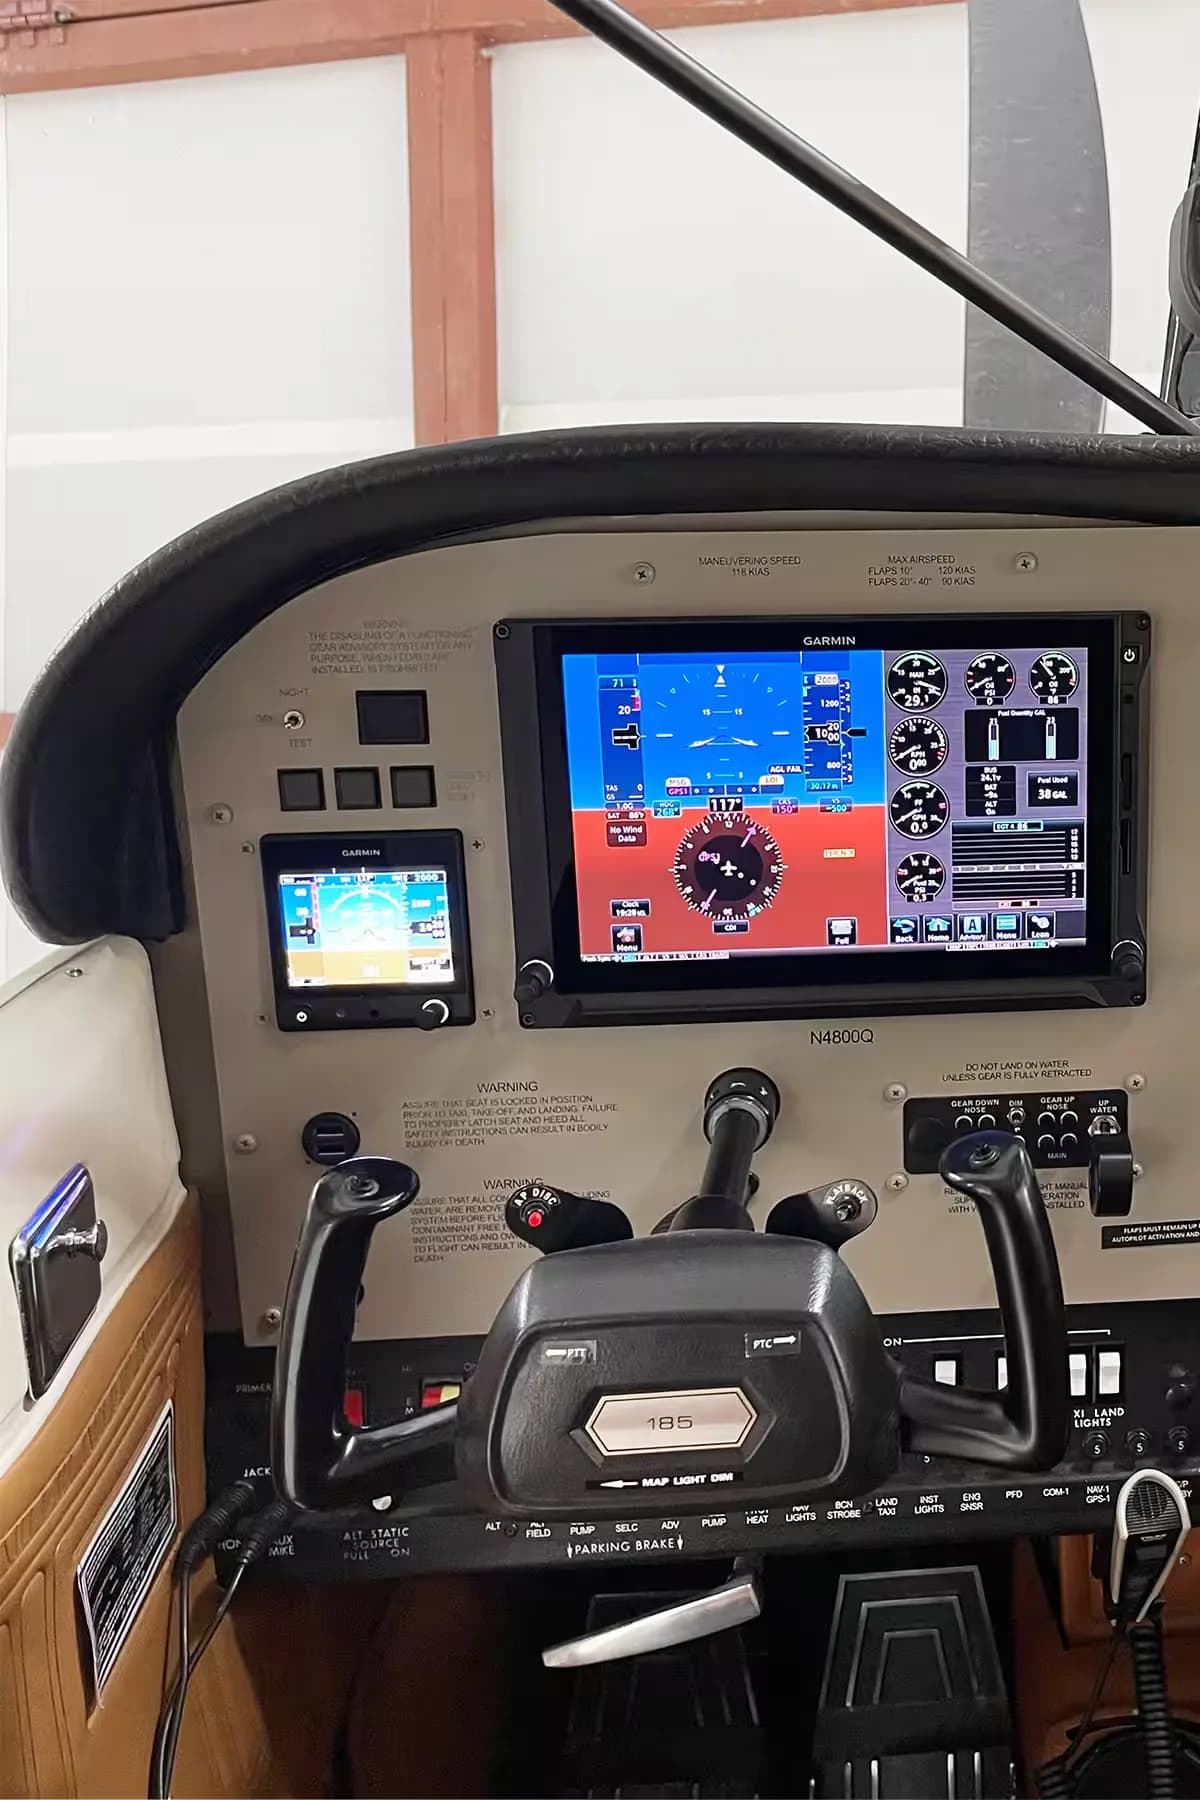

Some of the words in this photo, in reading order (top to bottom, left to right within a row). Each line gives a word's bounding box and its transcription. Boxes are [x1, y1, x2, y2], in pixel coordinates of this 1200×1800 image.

[699, 556, 768, 566] MANEUVERING
[769, 555, 801, 565] SPEED
[888, 555, 908, 564] MAX
[909, 555, 955, 564] AIRSPEED
[732, 567, 748, 576] 118
[748, 567, 770, 576] KIAS
[868, 566, 897, 576] FLAPS
[938, 566, 953, 575] 120
[955, 566, 976, 575] KIAS
[868, 577, 897, 586] FLAPS
[941, 577, 953, 586] 90
[954, 577, 975, 586] KIAS
[803, 636, 856, 646] GARMIN
[618, 706, 631, 715] 20
[1038, 789, 1051, 799] 38
[1053, 790, 1068, 799] GAL
[610, 826, 623, 834] No
[624, 826, 643, 834] Wind
[618, 834, 636, 842] Data
[342, 849, 380, 857] GARMIN
[810, 1029, 874, 1045] N4800Q
[965, 1063, 979, 1071] DO
[1000, 1062, 1023, 1070] LAND
[1025, 1061, 1038, 1069] ON
[1039, 1060, 1069, 1068] WATER
[942, 1073, 976, 1081] UNLESS
[978, 1072, 1001, 1080] GEAR
[1013, 1070, 1039, 1078] FULLY
[1041, 1069, 1092, 1077] RETRACTED
[477, 1081, 539, 1093] WARNING
[501, 1097, 537, 1105] LOCKED
[551, 1095, 593, 1104] POSITION
[1040, 1097, 1063, 1105] GEAR
[1098, 1099, 1109, 1107] UP
[1090, 1106, 1118, 1114] WATER
[1047, 1152, 1067, 1160] MAIN
[514, 1191, 527, 1206] AP
[532, 1187, 557, 1205] DISC
[1124, 1225, 1142, 1234] FLAPS
[1143, 1225, 1162, 1233] MUST
[1162, 1223, 1187, 1231] REMAIN
[1188, 1222, 1198, 1230] UP
[1112, 1233, 1147, 1243] AUTOPILOT
[1148, 1231, 1185, 1241] ACTIVATION
[1186, 1230, 1200, 1238] AND
[753, 1339, 772, 1350] PTC
[883, 1337, 902, 1347] ON
[647, 1415, 693, 1430] 185
[1074, 1418, 1112, 1429] LIGHTS
[642, 1477, 669, 1487] MAP
[673, 1475, 705, 1486] LIGHT
[710, 1473, 733, 1483] DIM
[1005, 1490, 1023, 1499] PFD
[1042, 1488, 1069, 1497] COM-1
[1087, 1485, 1110, 1494] NAV-1
[875, 1497, 898, 1507] LAND
[920, 1495, 939, 1504] INST
[963, 1493, 981, 1502] ENG
[1086, 1494, 1110, 1504] GPS-1
[835, 1500, 853, 1509] BCN
[914, 1504, 945, 1514] LIGHTS
[960, 1502, 984, 1512] SNSR
[785, 1511, 817, 1522] LIGHTS
[826, 1509, 861, 1520] STROBE
[878, 1507, 896, 1516] TAXI
[661, 1520, 680, 1530] ADV
[702, 1517, 727, 1528] PUMP
[746, 1515, 768, 1525] HEAT
[569, 1525, 595, 1536] PUMP
[615, 1523, 639, 1532] SELC
[526, 1528, 551, 1538] FIELD
[575, 1541, 631, 1555] PARKING
[635, 1537, 675, 1551] BRAKE
[268, 1546, 295, 1557] MIKE
[390, 1548, 410, 1558] ON
